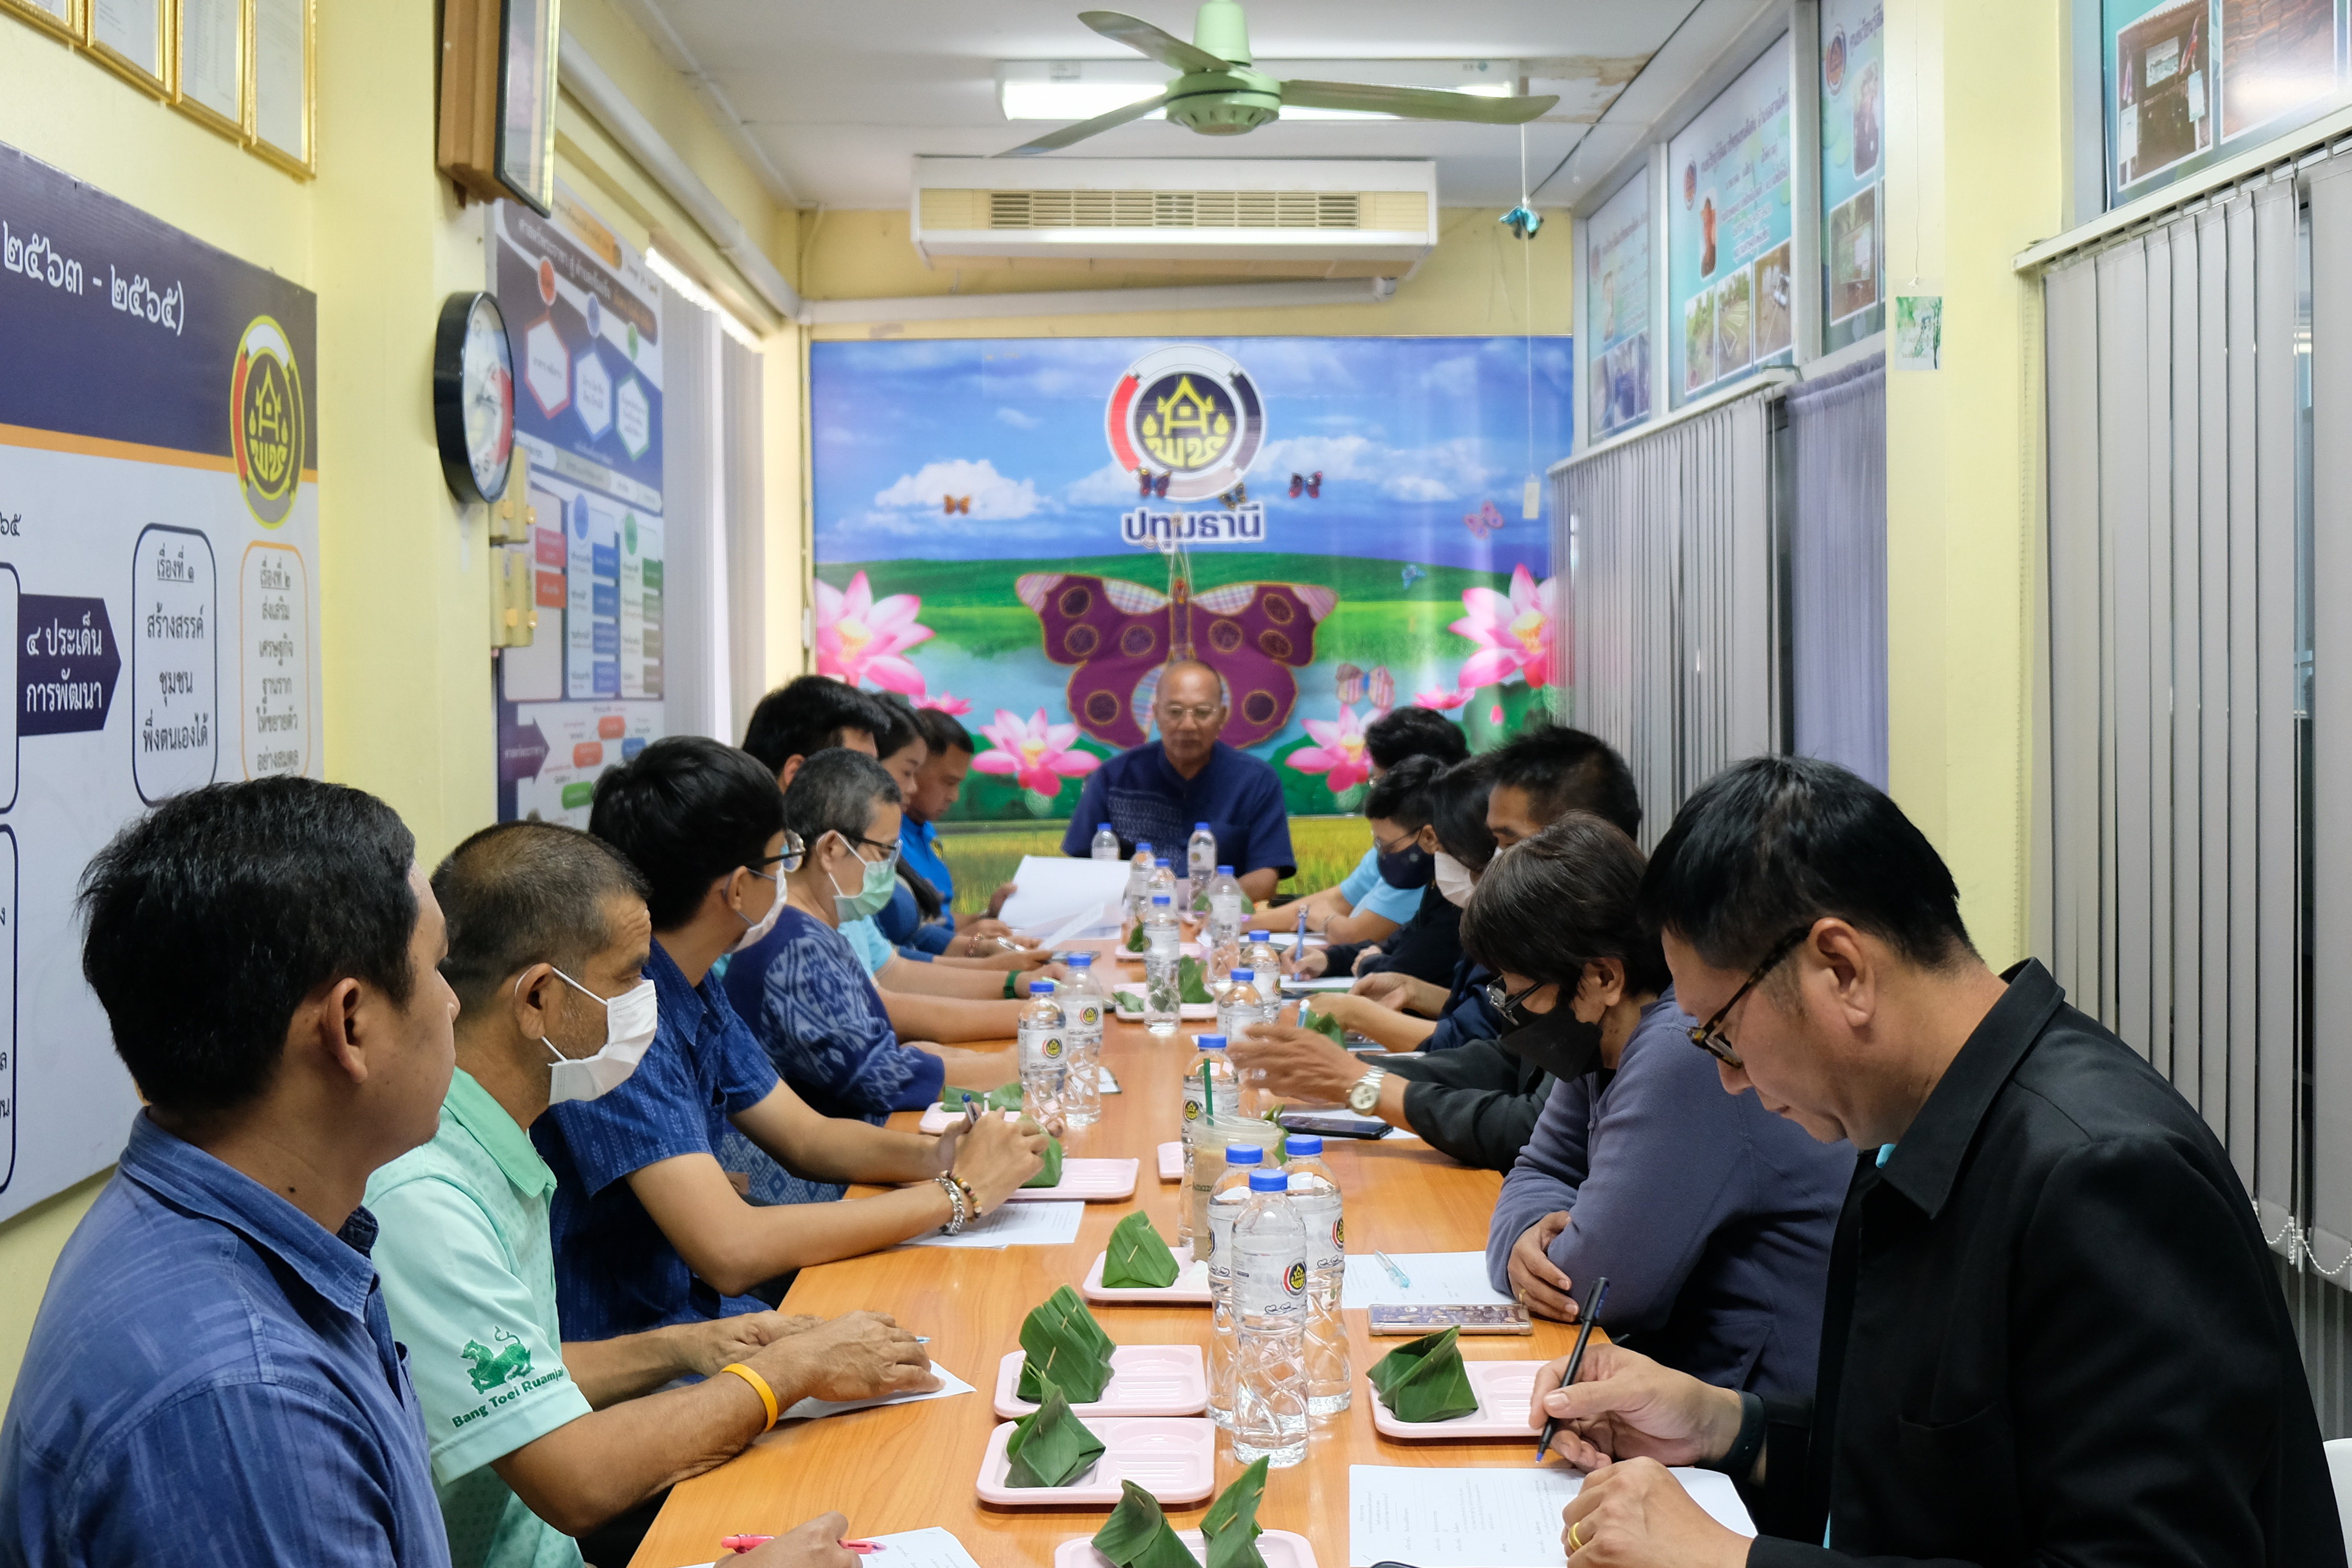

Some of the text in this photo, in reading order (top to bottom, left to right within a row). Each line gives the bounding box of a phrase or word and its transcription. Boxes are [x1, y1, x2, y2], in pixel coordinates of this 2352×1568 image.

[3, 220, 83, 295] ๒๕๖๓
[110, 264, 185, 336] ๒๕๖๕)
[1124, 503, 1262, 549] ปทุมธานี
[157, 543, 194, 580] เรื่องที่ ๑
[27, 610, 102, 655] ๔ ประเด็น
[147, 602, 204, 639] สร้างสรรค์
[27, 667, 102, 712] การพัฒนา
[159, 671, 193, 707] ชุมชน
[142, 709, 209, 753] พึ่งตนเองได้
[452, 1366, 564, 1428] Bang Toei Ruamjai
